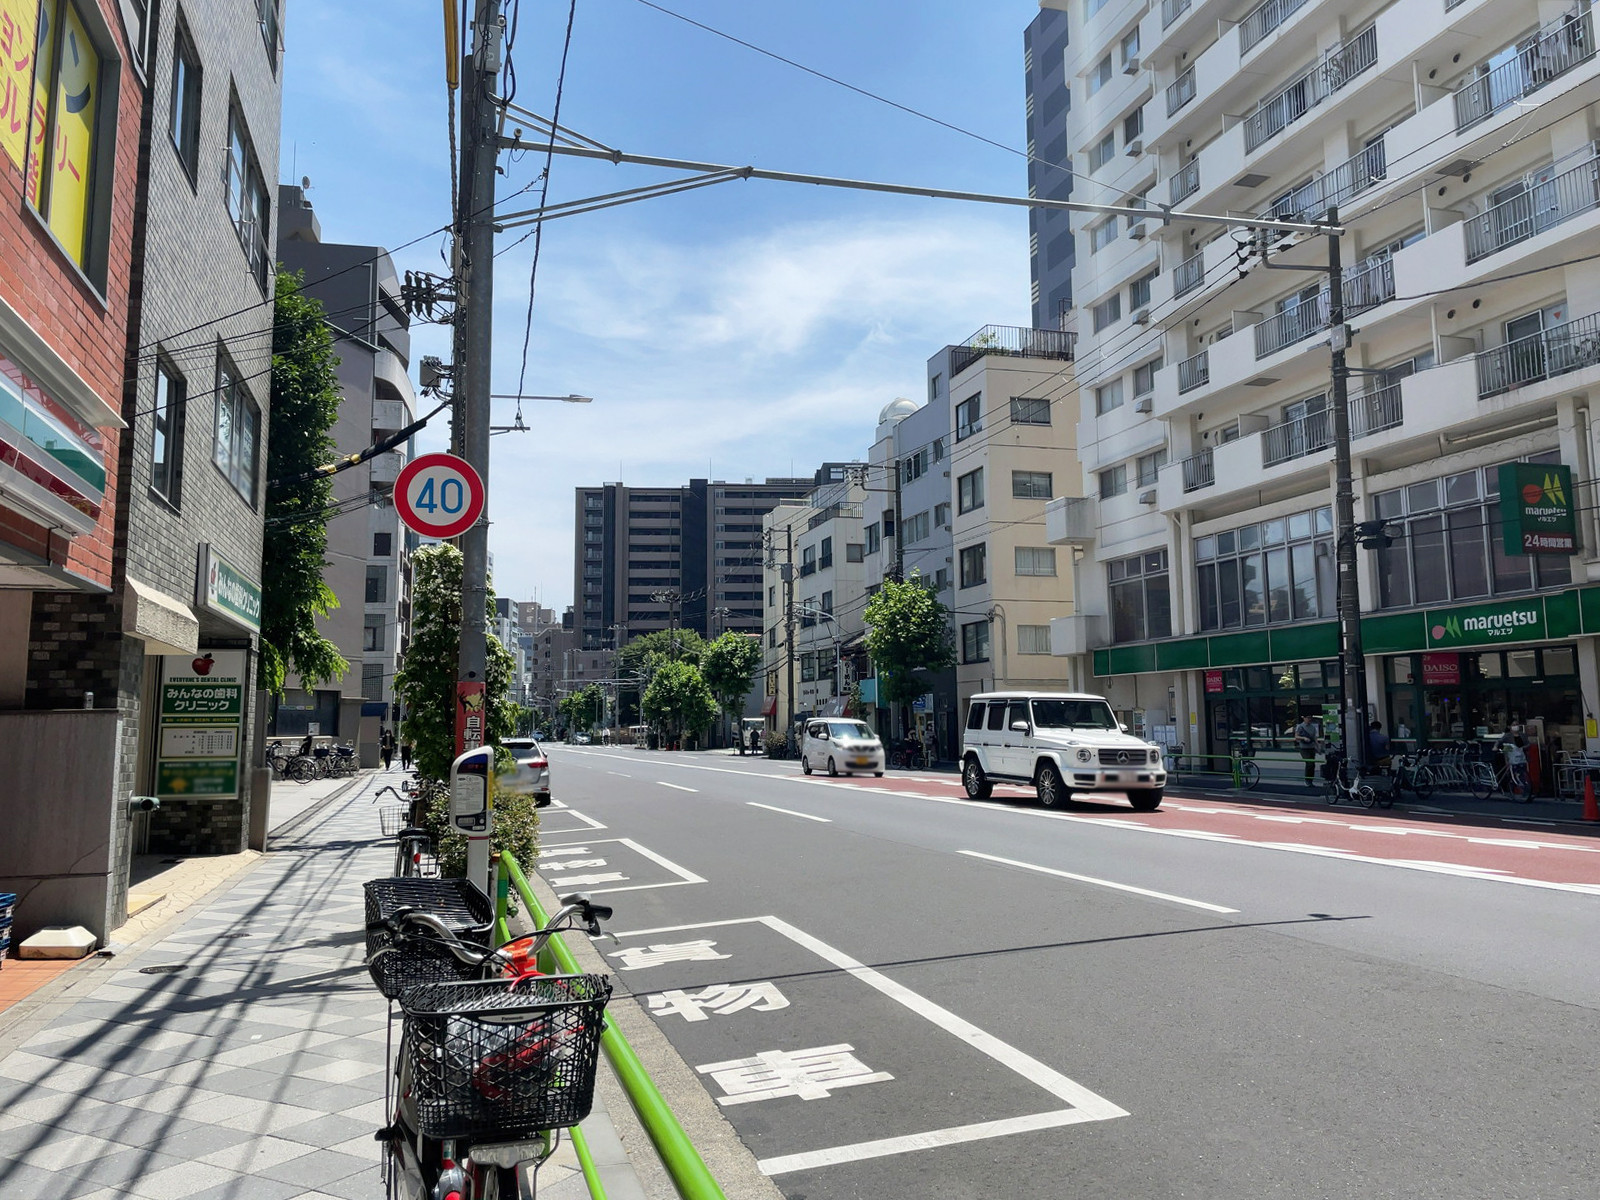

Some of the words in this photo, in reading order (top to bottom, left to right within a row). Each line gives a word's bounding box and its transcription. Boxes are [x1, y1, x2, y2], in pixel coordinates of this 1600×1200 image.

[415, 477, 463, 514] 40
[1524, 534, 1573, 548] 24時間営業
[1463, 610, 1537, 631] maruetsu
[1487, 627, 1513, 637] マルエツ
[1423, 663, 1458, 672] DAISO
[166, 687, 238, 699] みんなの歯科
[174, 699, 230, 711] クリニック
